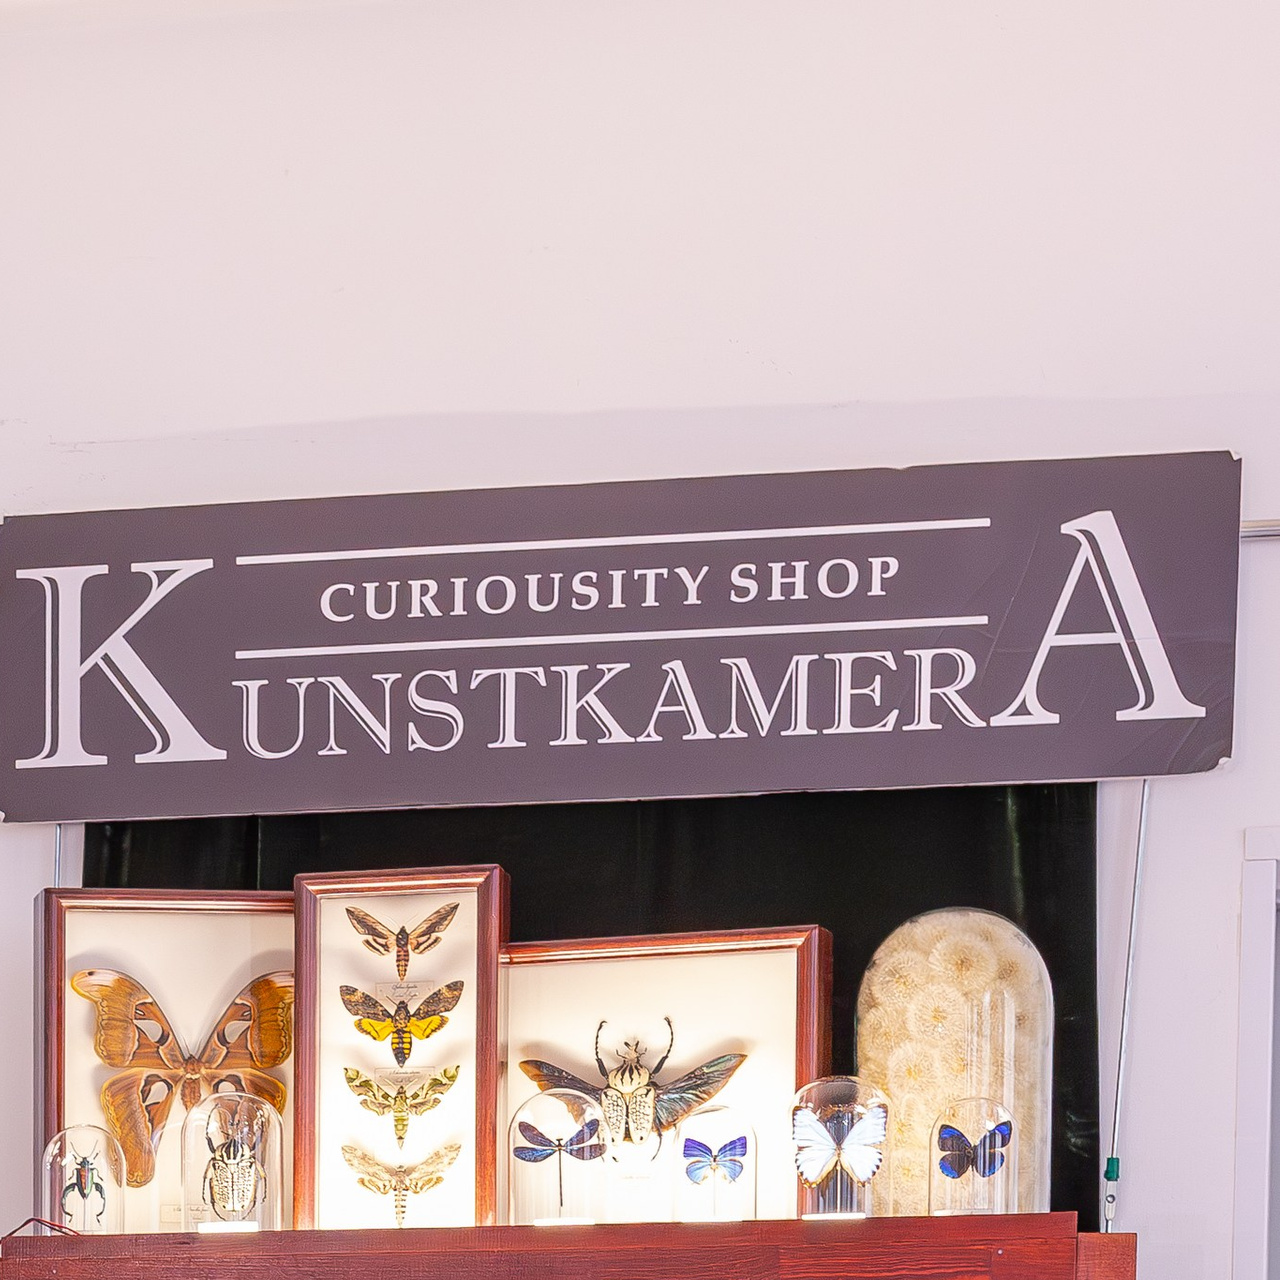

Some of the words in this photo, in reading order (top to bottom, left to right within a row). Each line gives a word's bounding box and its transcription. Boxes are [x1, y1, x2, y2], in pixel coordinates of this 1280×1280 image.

[15, 510, 1207, 769] KUNSTKAMERA
[319, 566, 710, 622] CURIOUSITY
[729, 556, 900, 603] SHOP
